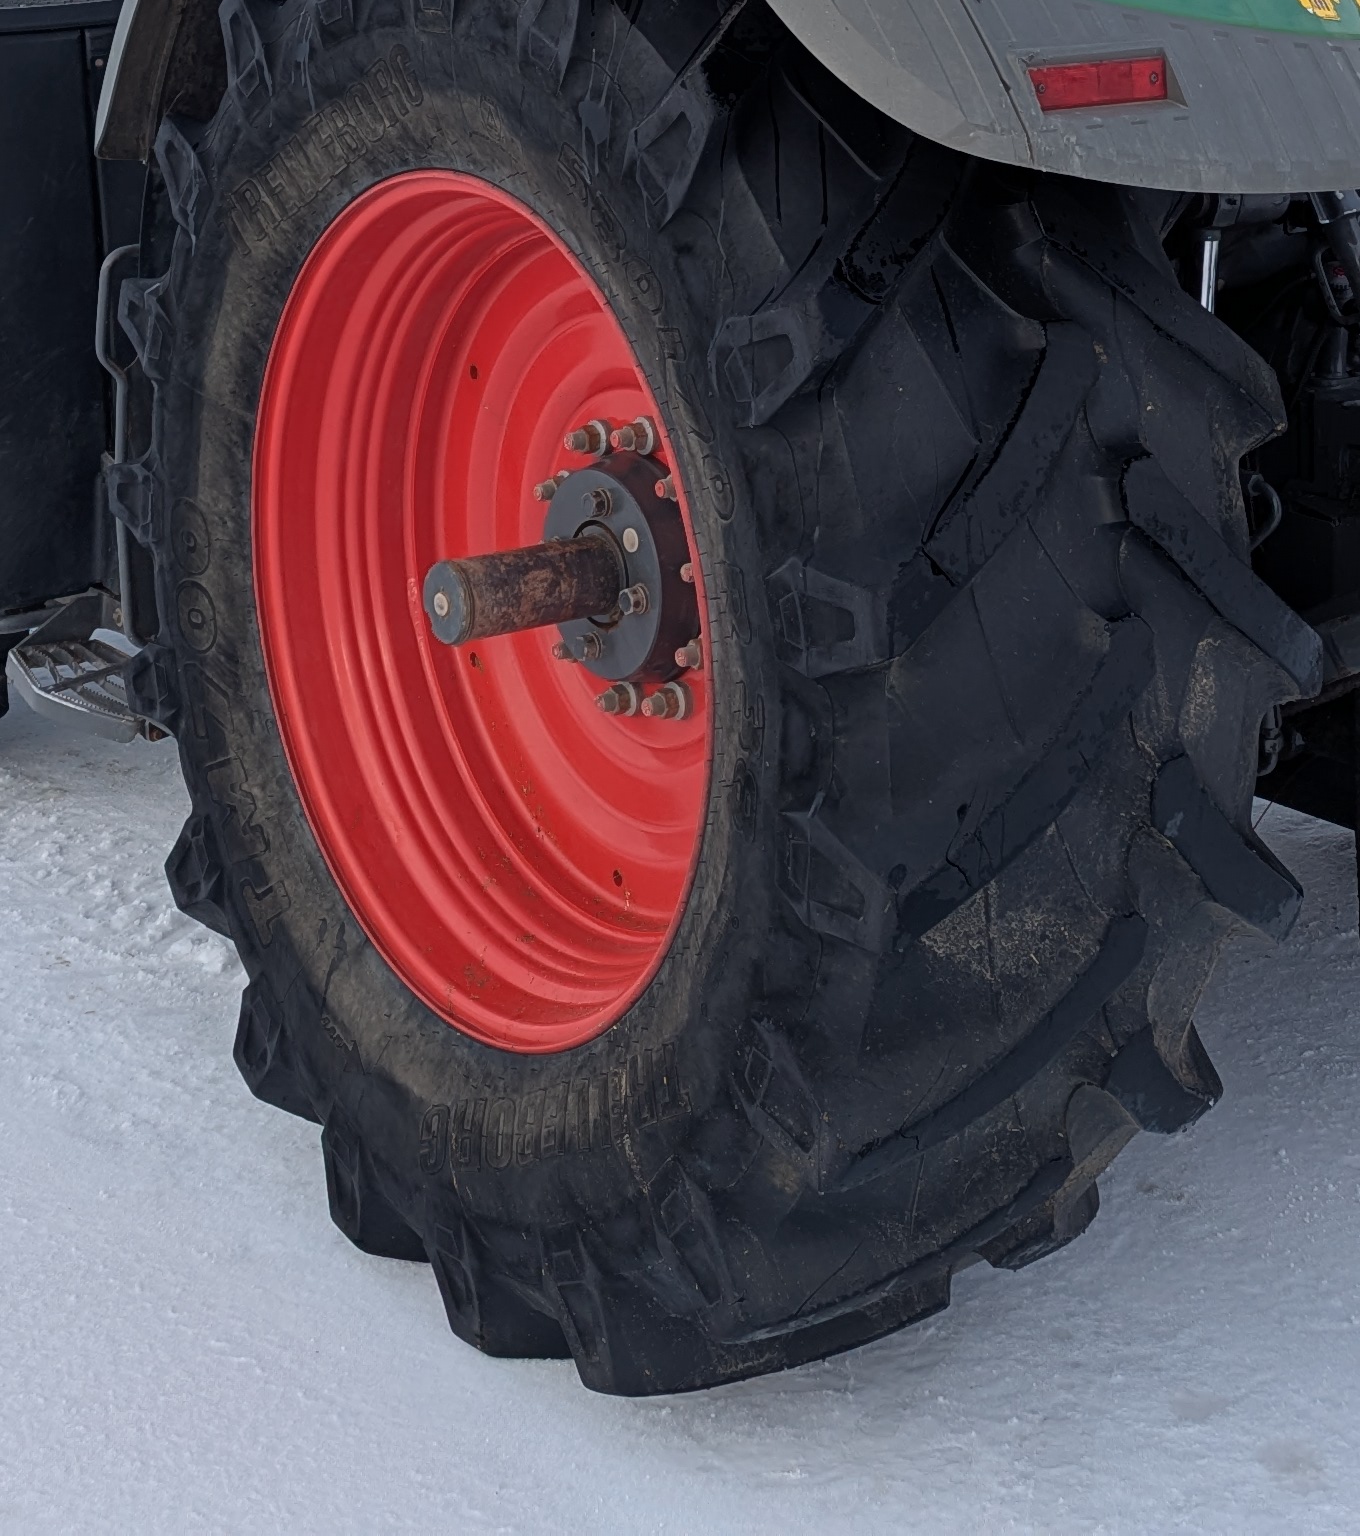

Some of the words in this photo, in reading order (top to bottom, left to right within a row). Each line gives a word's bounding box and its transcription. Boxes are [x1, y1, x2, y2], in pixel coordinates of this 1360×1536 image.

[215, 43, 426, 256] TRELLEBORG
[169, 496, 292, 950] TM700
[418, 1042, 692, 1176] TRELLEBORG
